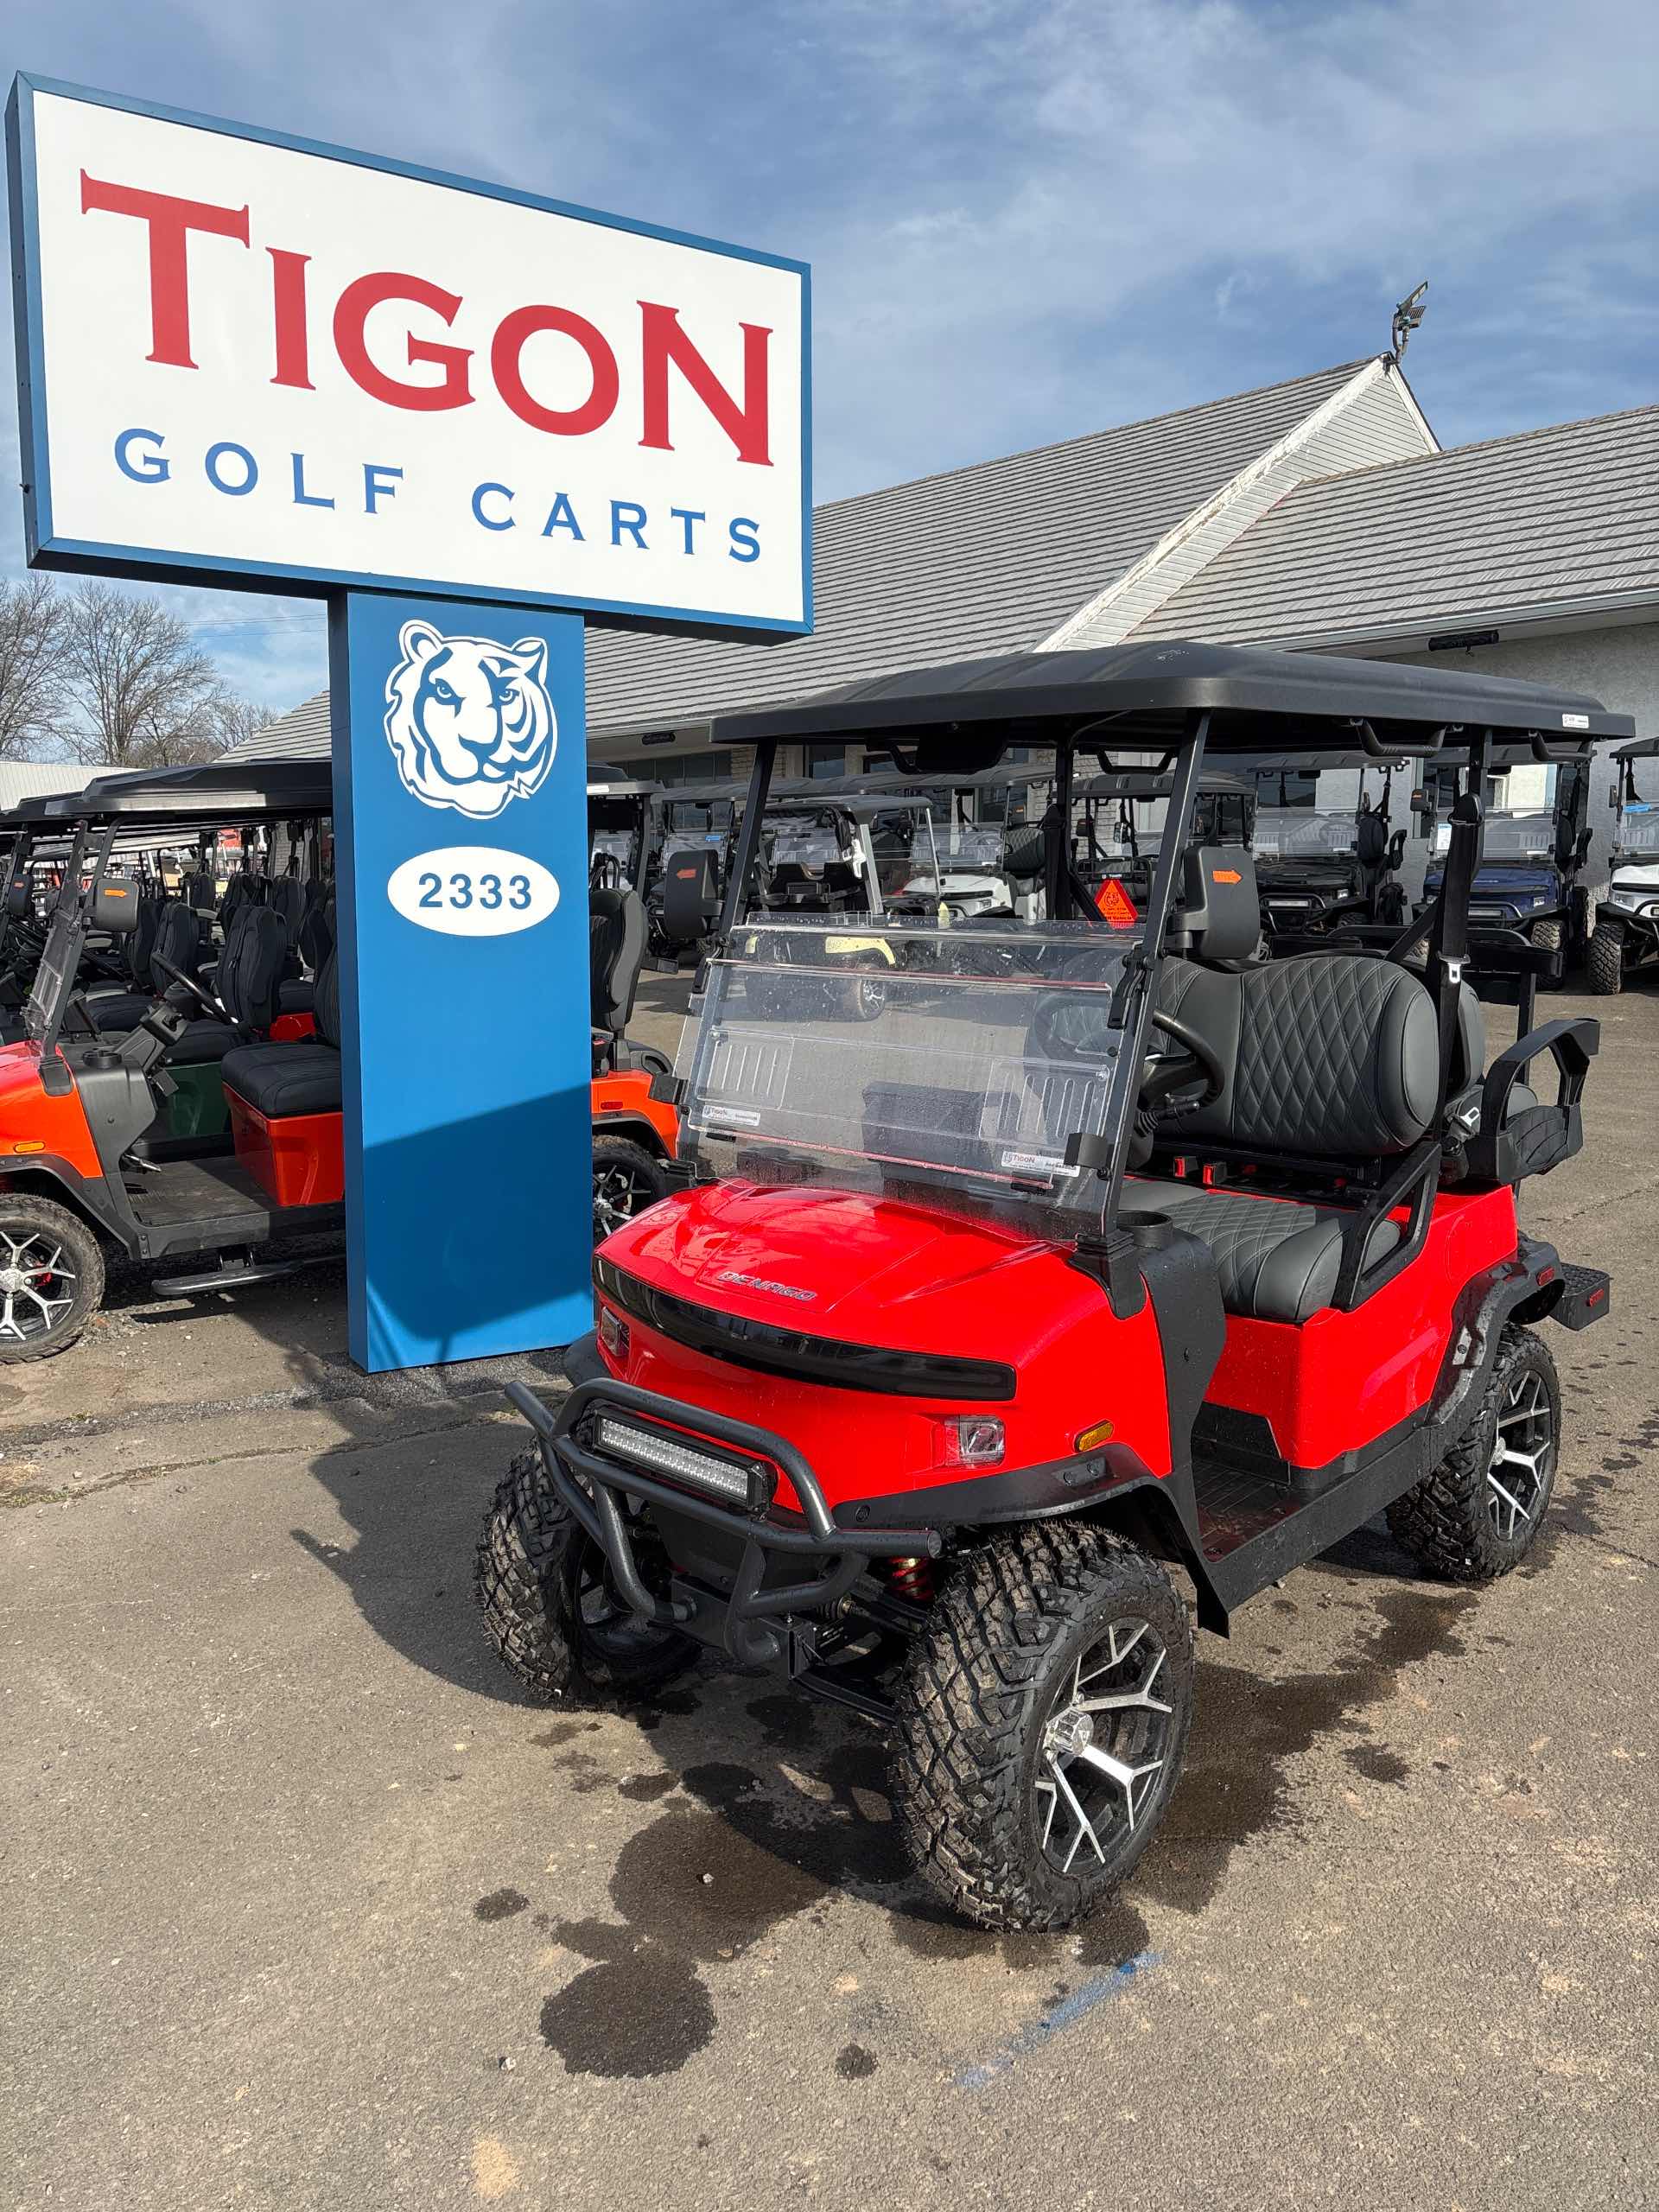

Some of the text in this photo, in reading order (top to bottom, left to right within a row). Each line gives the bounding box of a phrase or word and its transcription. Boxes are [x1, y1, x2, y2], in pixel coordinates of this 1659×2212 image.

[80, 168, 774, 467] TIGON
[113, 428, 761, 563] GOLF CARTS
[418, 872, 532, 911] 2333
[717, 1270, 817, 1301] DENAGO
